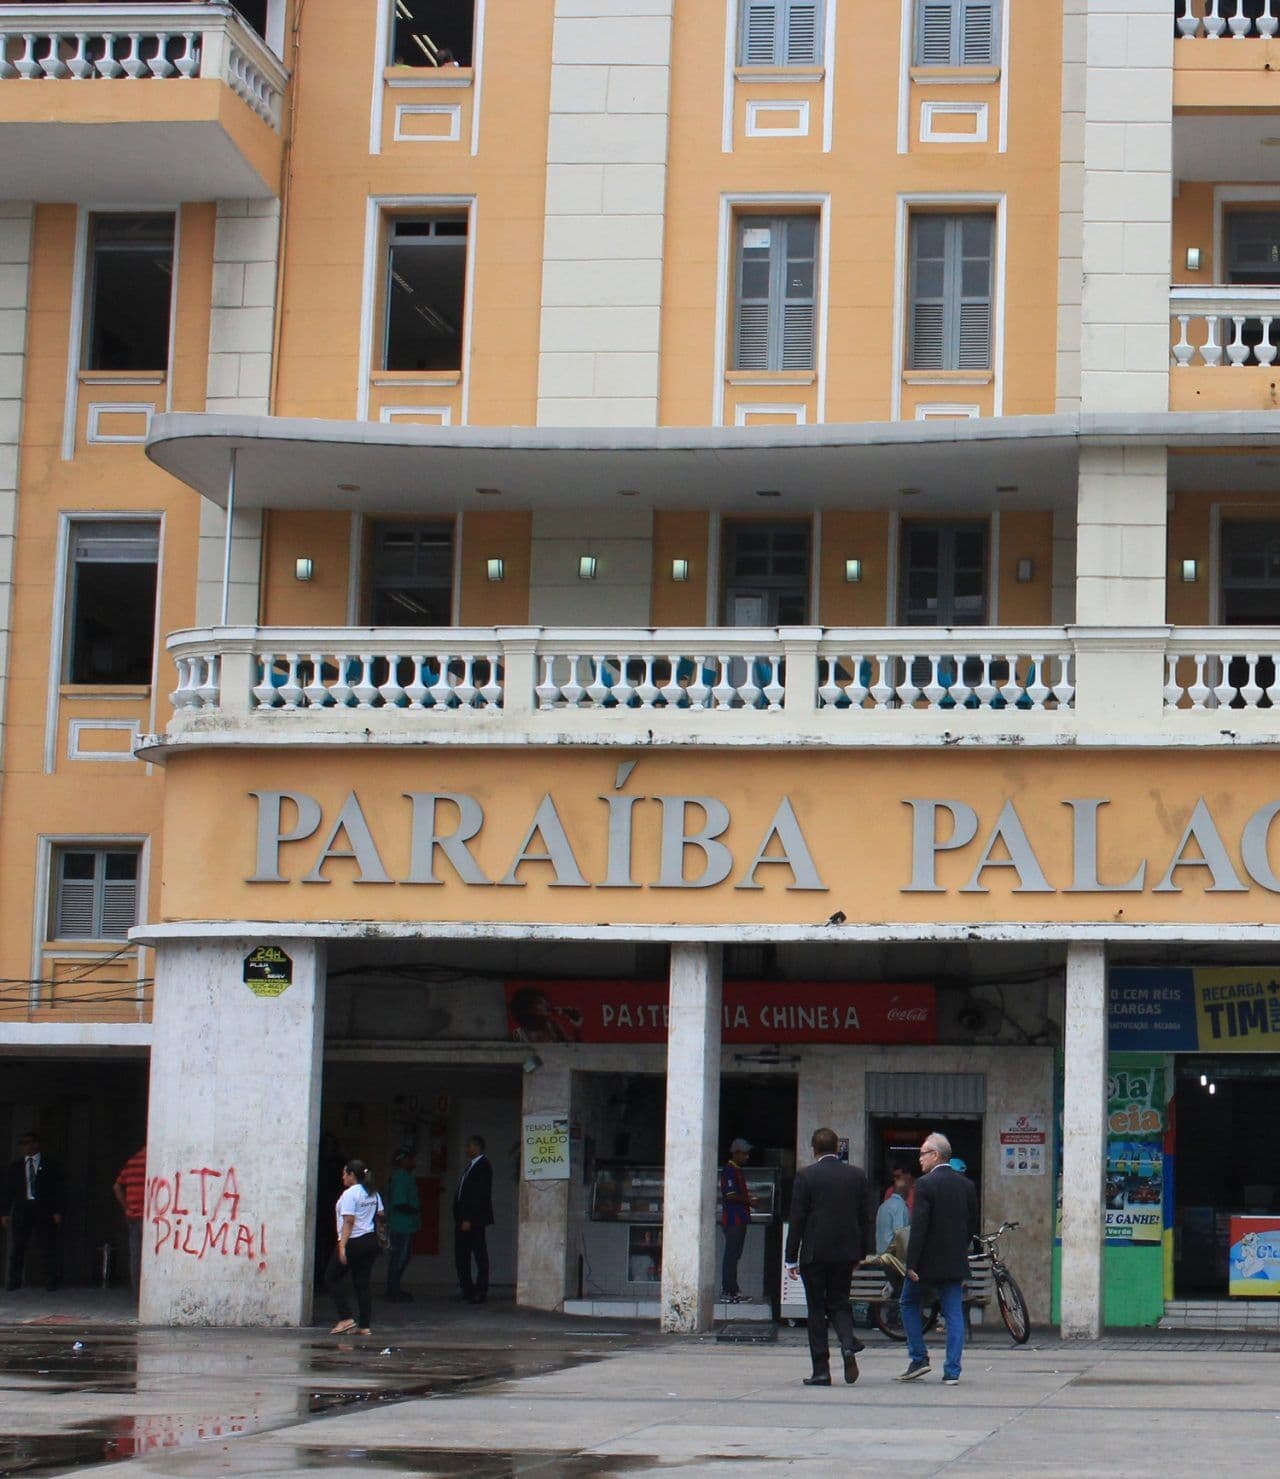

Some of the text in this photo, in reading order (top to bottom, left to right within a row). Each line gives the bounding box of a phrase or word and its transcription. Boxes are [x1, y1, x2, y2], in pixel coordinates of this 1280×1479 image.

[245, 760, 829, 891] PARAÍBA
[1123, 989, 1149, 1000] CEM
[1153, 987, 1181, 1000] RÉIS
[1202, 983, 1264, 1001] RECARGA
[1108, 1003, 1162, 1014] ECARGAS
[759, 1005, 861, 1029] CHINESA
[1204, 999, 1269, 1039] TIM
[526, 1136, 568, 1145] CALDO
[539, 1146, 556, 1154] DE
[530, 1155, 565, 1165] CANA
[146, 1167, 240, 1222] VOLTA
[1116, 1214, 1161, 1225] GANHE!
